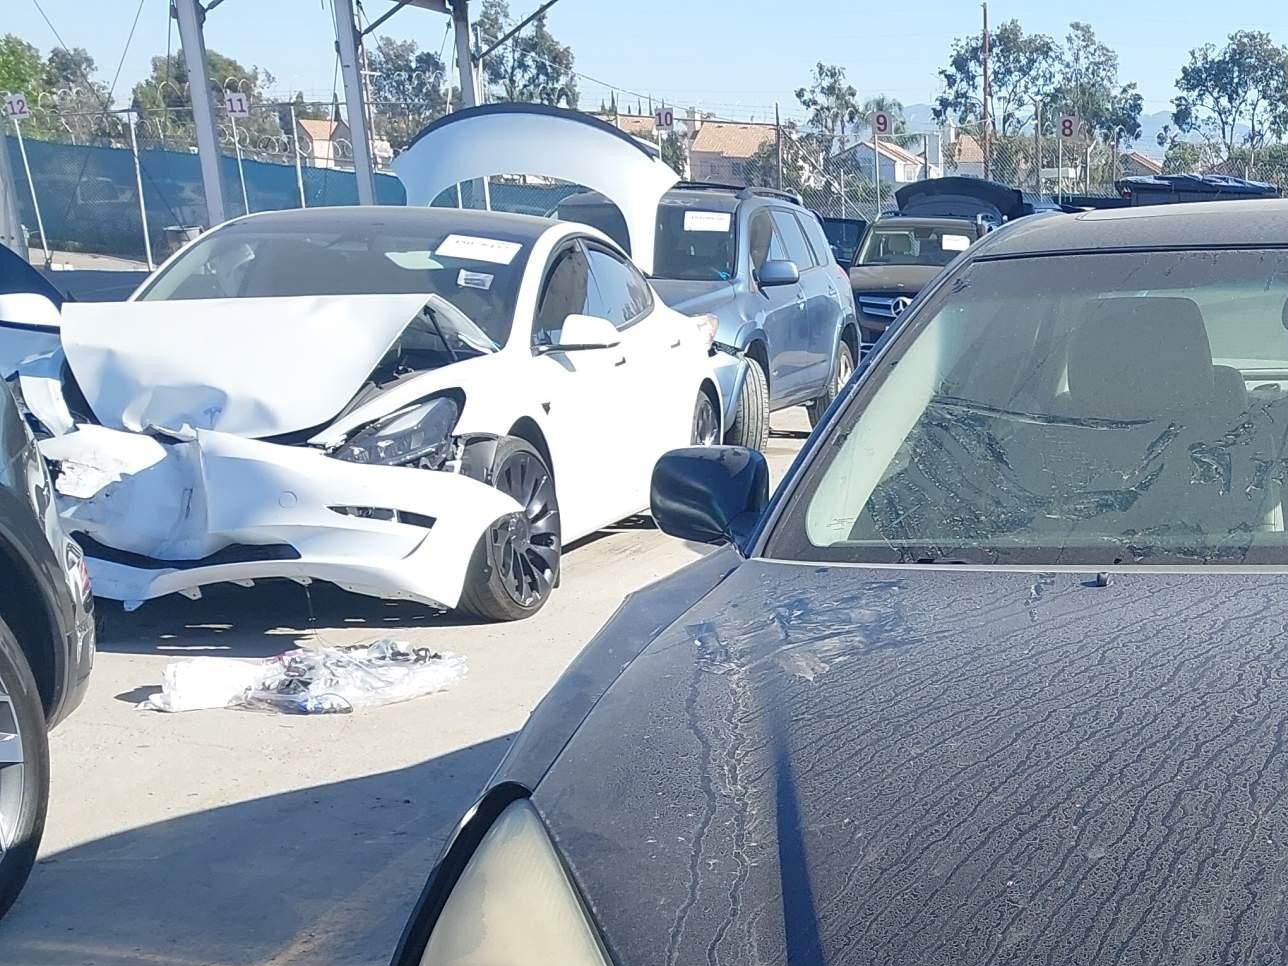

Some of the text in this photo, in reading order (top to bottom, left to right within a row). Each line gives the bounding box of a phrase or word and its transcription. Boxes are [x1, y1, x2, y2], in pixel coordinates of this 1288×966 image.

[7, 99, 27, 116] 12
[227, 97, 247, 113] 11
[656, 111, 673, 127] 10
[876, 114, 888, 132] 9
[1061, 119, 1074, 137] 8
